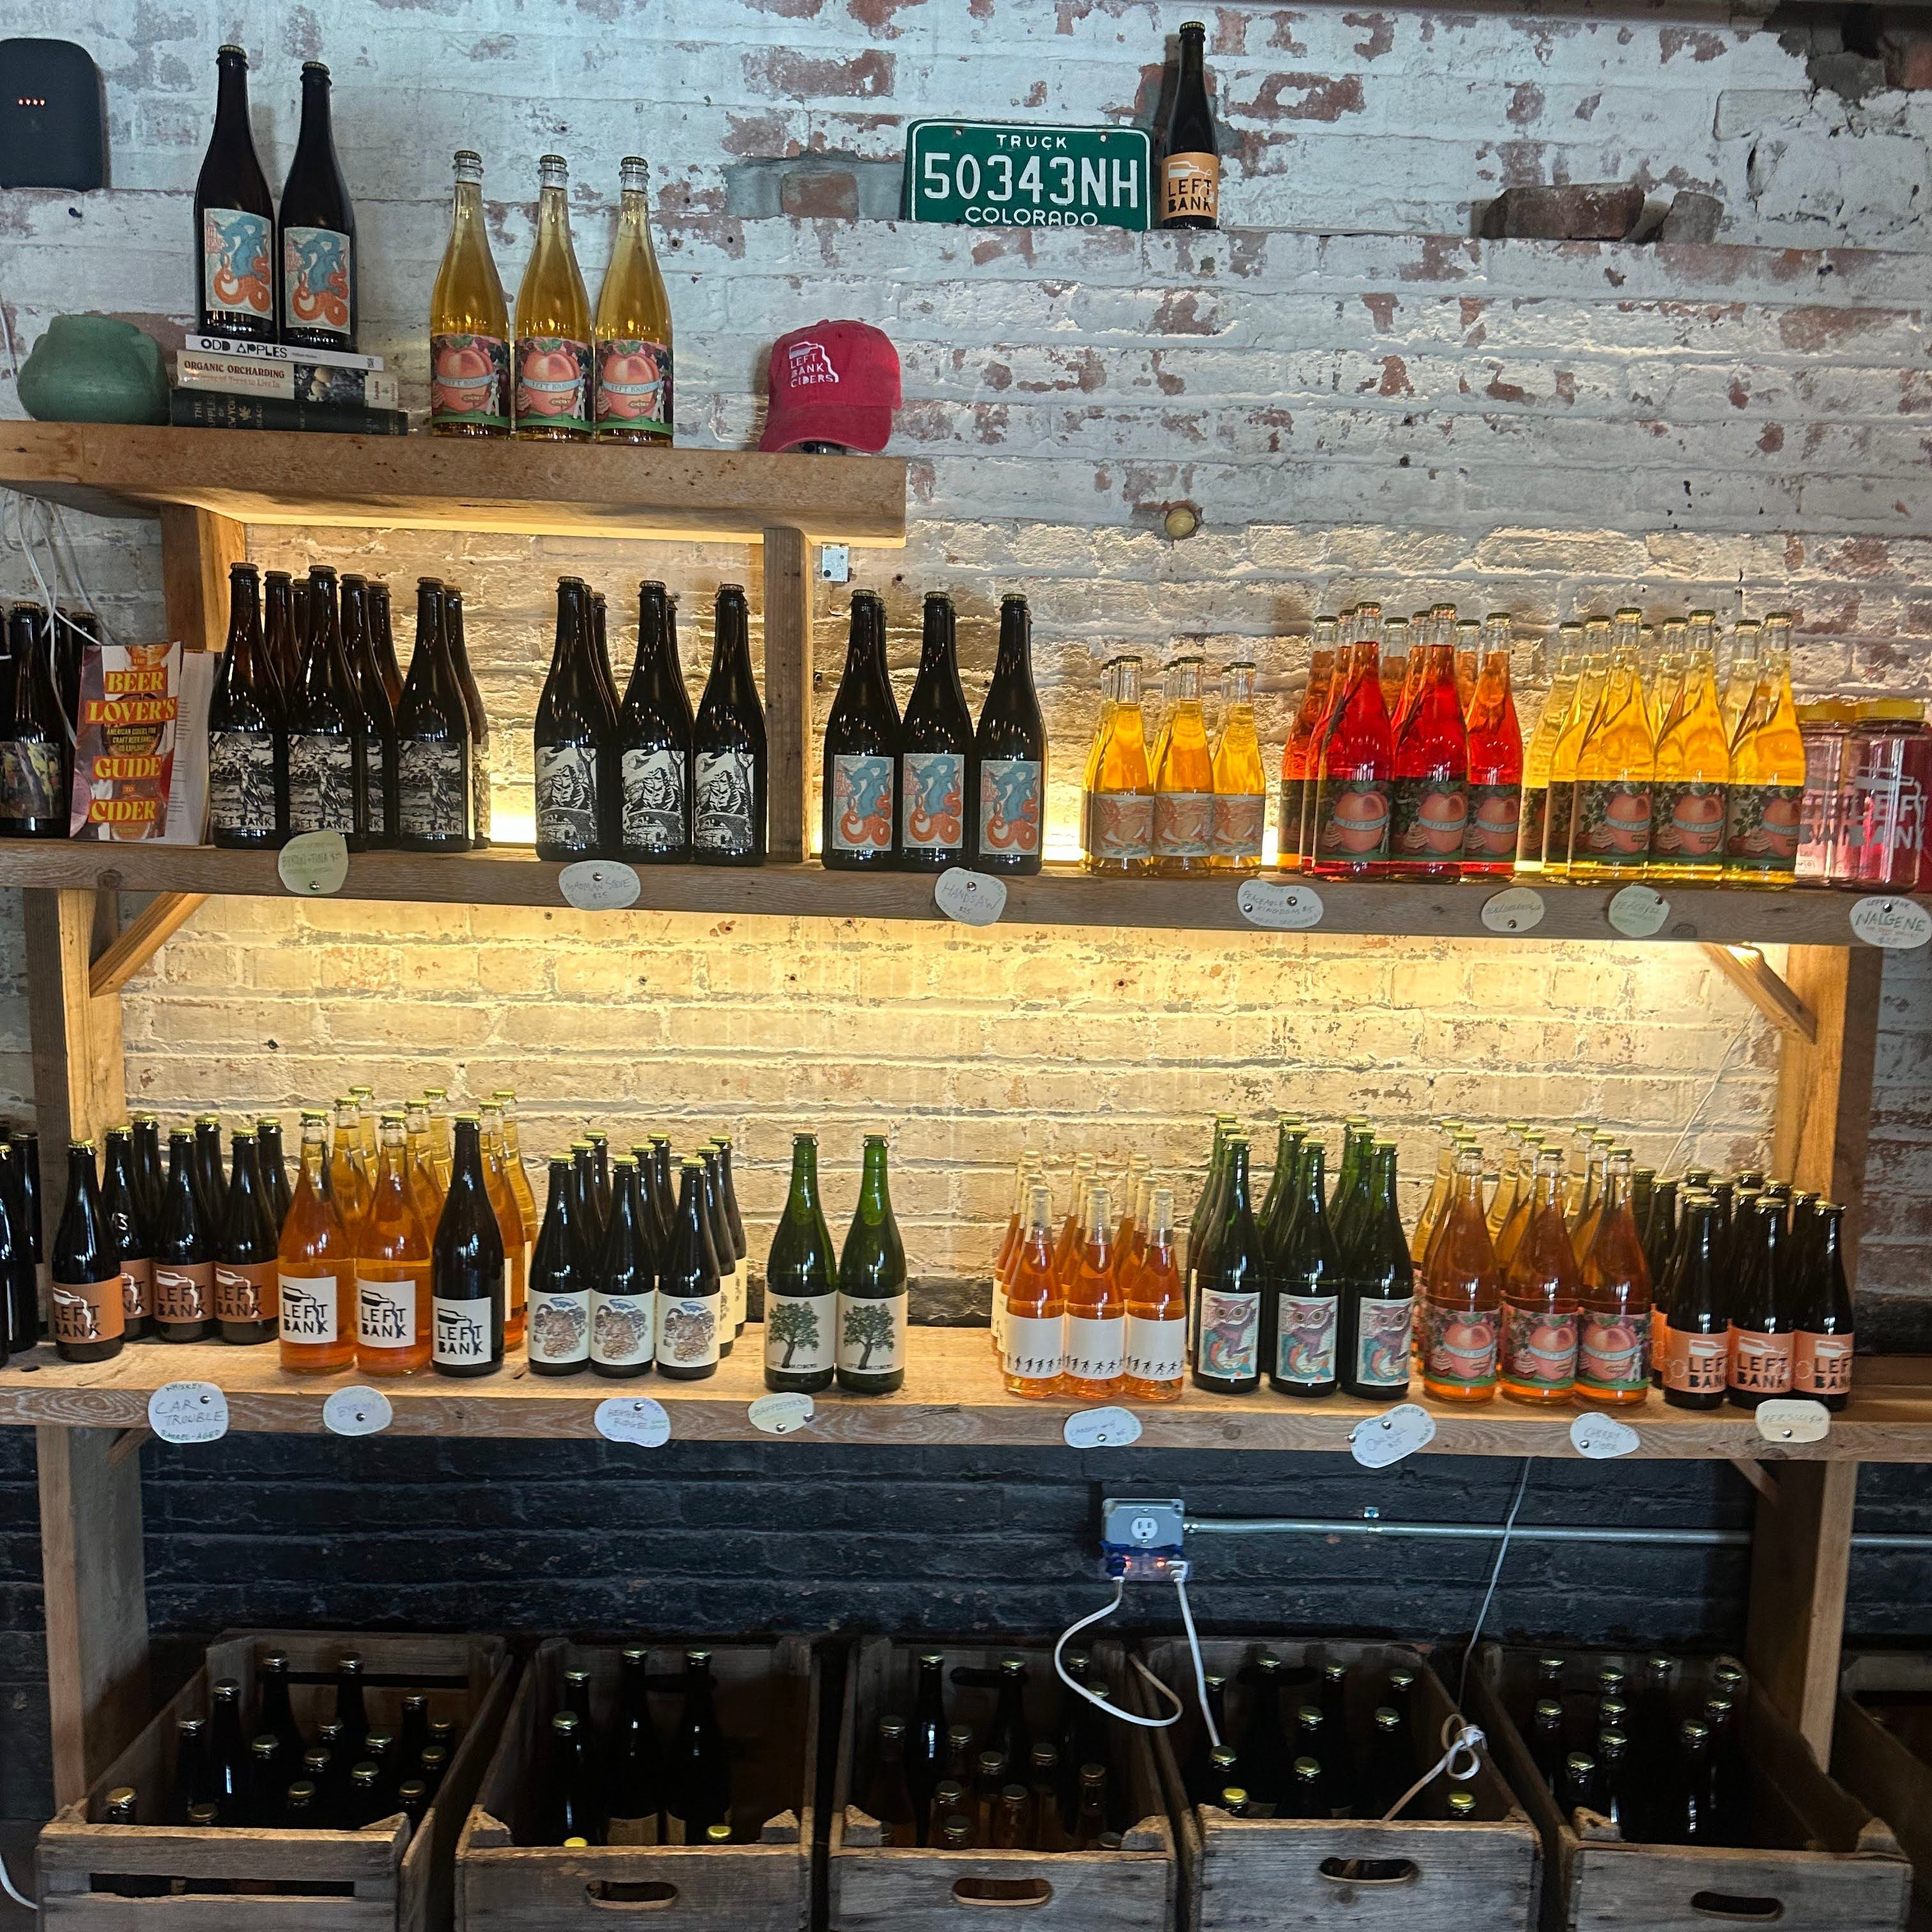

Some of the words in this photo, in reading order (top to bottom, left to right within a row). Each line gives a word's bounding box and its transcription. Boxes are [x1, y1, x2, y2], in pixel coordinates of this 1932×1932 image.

[995, 134, 1068, 150] TRUCK
[923, 152, 1138, 208] 50343NH
[1169, 178, 1212, 197] LEFT
[1168, 197, 1212, 214] BANK
[964, 205, 1099, 227] COLORADO
[201, 338, 231, 351] ODD
[236, 342, 288, 359] APPLES
[184, 360, 224, 373] ORGANIC
[227, 364, 286, 379] ORCHARDING
[790, 353, 818, 369] LEFT
[791, 362, 825, 379] BANK
[790, 374, 834, 388] CIDERS
[108, 671, 164, 693] BEER
[89, 698, 175, 723] LOVER'S
[95, 757, 162, 778] GUIDE
[91, 800, 157, 822] CIDER
[1850, 795, 1928, 823] LEFT
[941, 882, 1003, 910] HANDSAW
[1243, 889, 1285, 907] PEACEABLE
[1257, 905, 1300, 916] KINGDOM
[1854, 910, 1928, 932] NALGENE
[157, 1284, 206, 1302] LEFT
[216, 1284, 262, 1301] LEFT
[157, 1300, 206, 1317] BANK
[282, 1302, 329, 1319] LEFT
[361, 1307, 407, 1323] LEFT
[282, 1318, 329, 1335] BANK
[361, 1322, 407, 1339] BANK
[437, 1324, 484, 1341] LEFT
[438, 1340, 484, 1356] BANK
[1737, 1353, 1788, 1374] LEFT
[1736, 1372, 1788, 1388] BANK
[155, 1399, 198, 1415] CAR
[164, 1410, 225, 1427] TROUBLE
